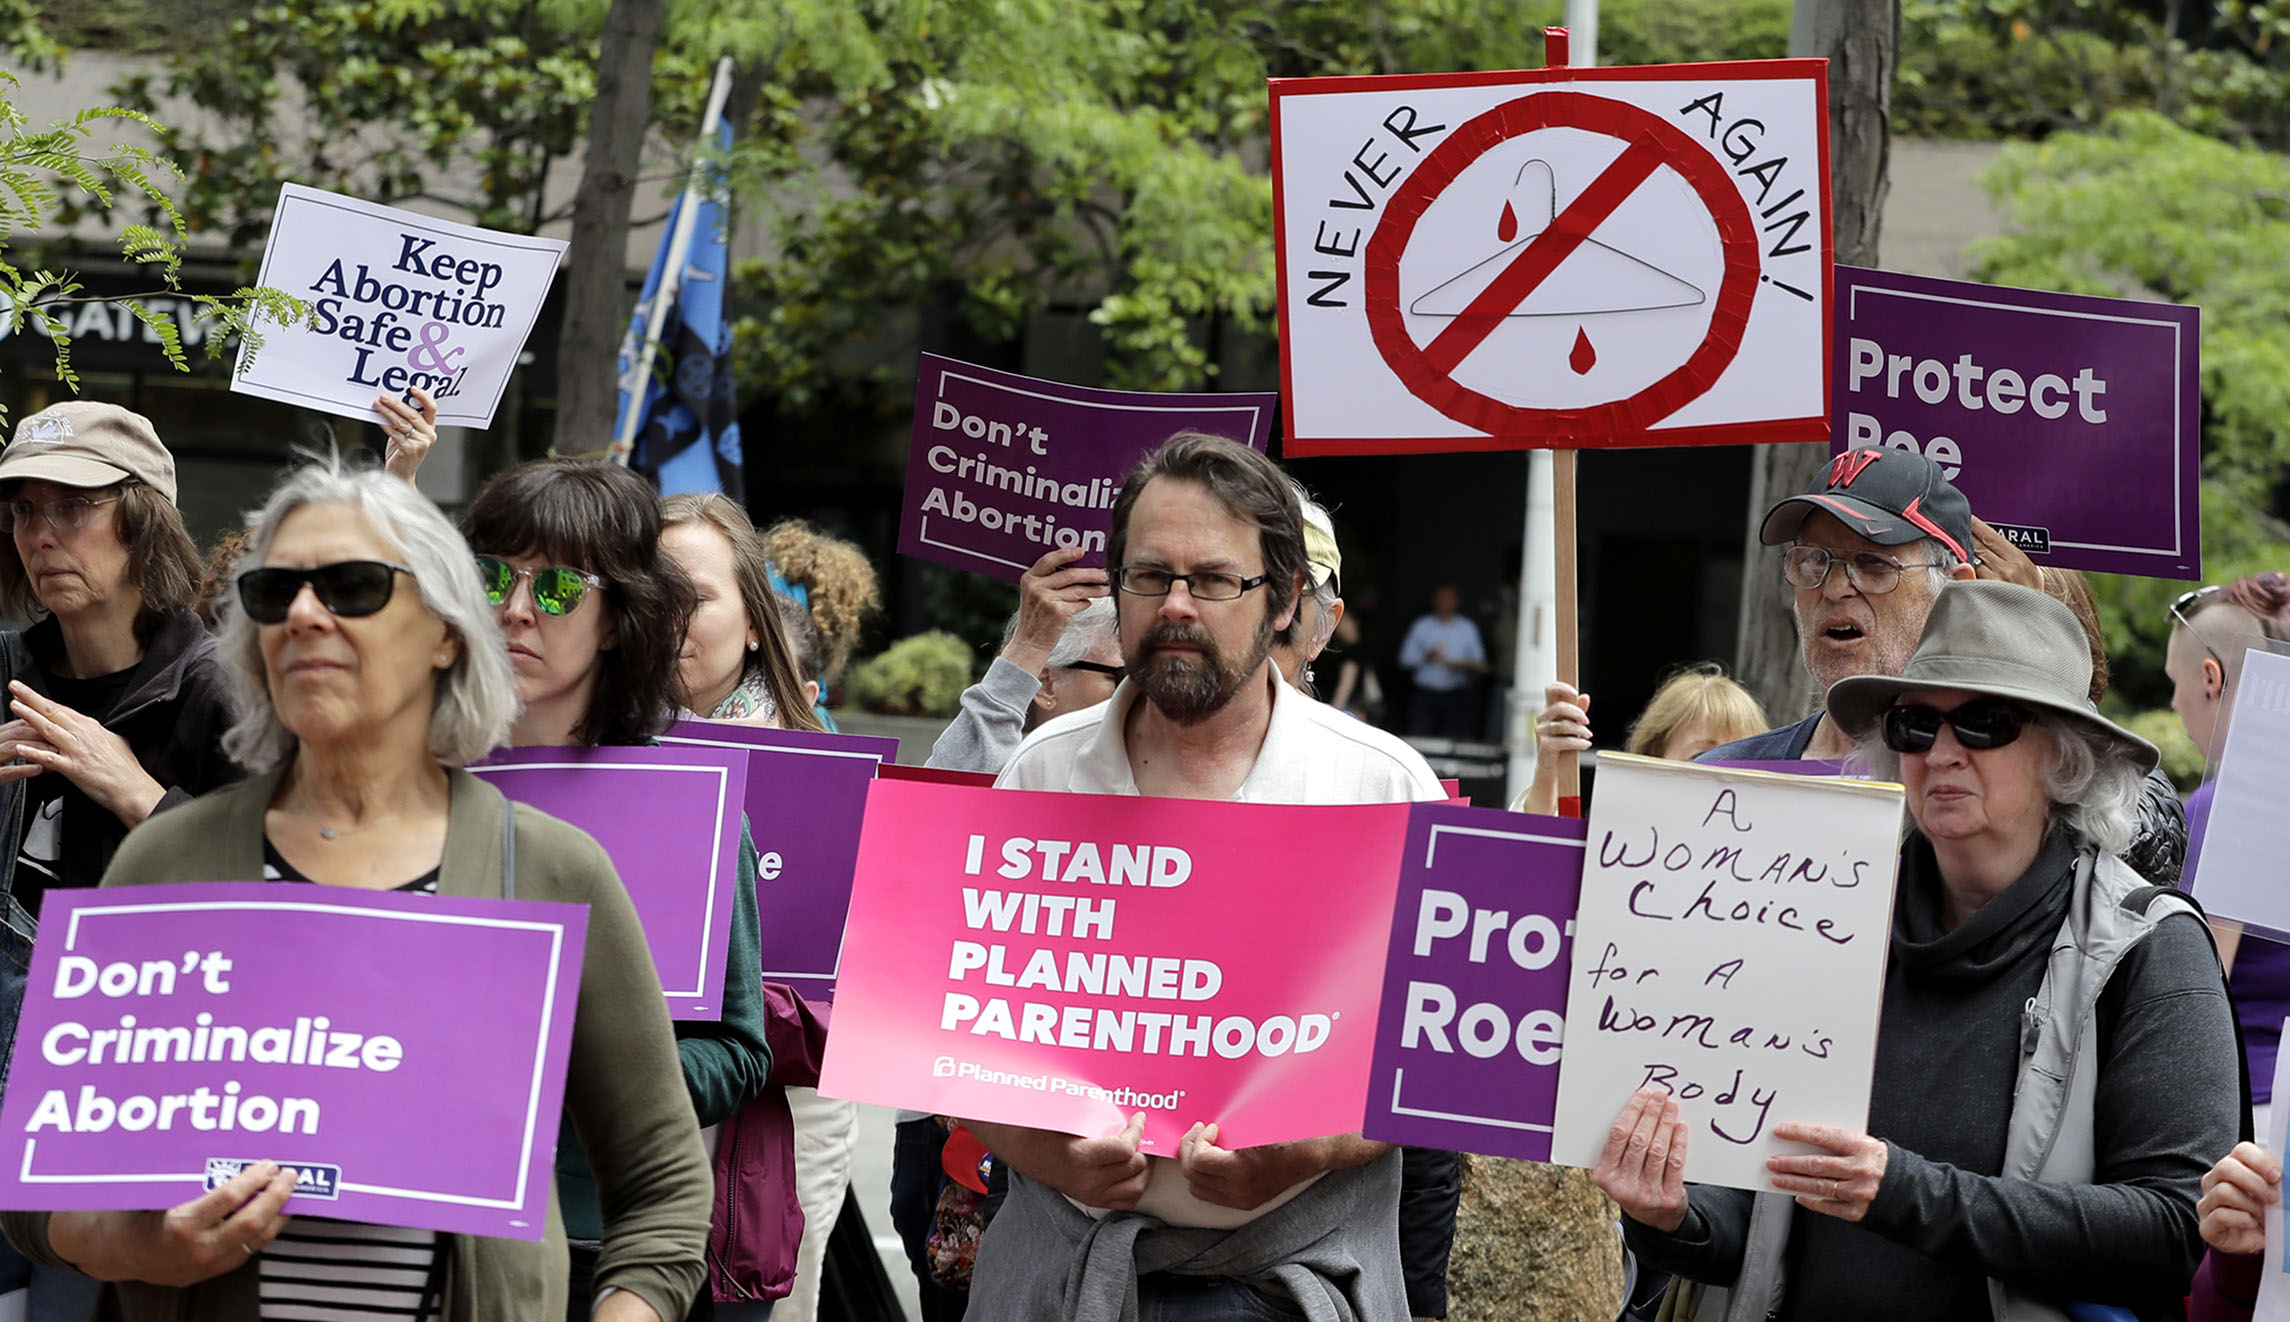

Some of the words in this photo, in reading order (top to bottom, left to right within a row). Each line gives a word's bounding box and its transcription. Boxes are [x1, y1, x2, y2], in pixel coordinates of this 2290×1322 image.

[1307, 105, 1446, 308] NEVER
[1680, 92, 1812, 302] AGAIN!
[309, 257, 506, 329] Abortion
[392, 233, 503, 301] Keep
[31, 296, 239, 348] GATEW
[315, 298, 412, 353] Safe
[407, 321, 465, 376] &
[1848, 336, 2108, 425] Protect
[931, 400, 1049, 457] Don't
[1826, 449, 1884, 489] W
[920, 486, 1106, 552] Abortion
[1996, 528, 2044, 544] ARAL
[1702, 789, 1752, 832] A
[964, 834, 985, 875] I
[997, 837, 1193, 888] STAND
[961, 887, 1116, 940] WITH
[1413, 889, 1576, 970] Pro
[1629, 879, 1855, 945] Choice
[53, 951, 233, 999] Don't
[948, 940, 1223, 1001] PLANNED
[1588, 942, 1659, 989] for
[1704, 958, 1744, 990] A
[41, 1012, 404, 1072] Criminalize
[1400, 981, 1565, 1066] Roe
[958, 1062, 1048, 1092] Planned
[1636, 1063, 1778, 1145] Body
[25, 1081, 321, 1136] Abortion
